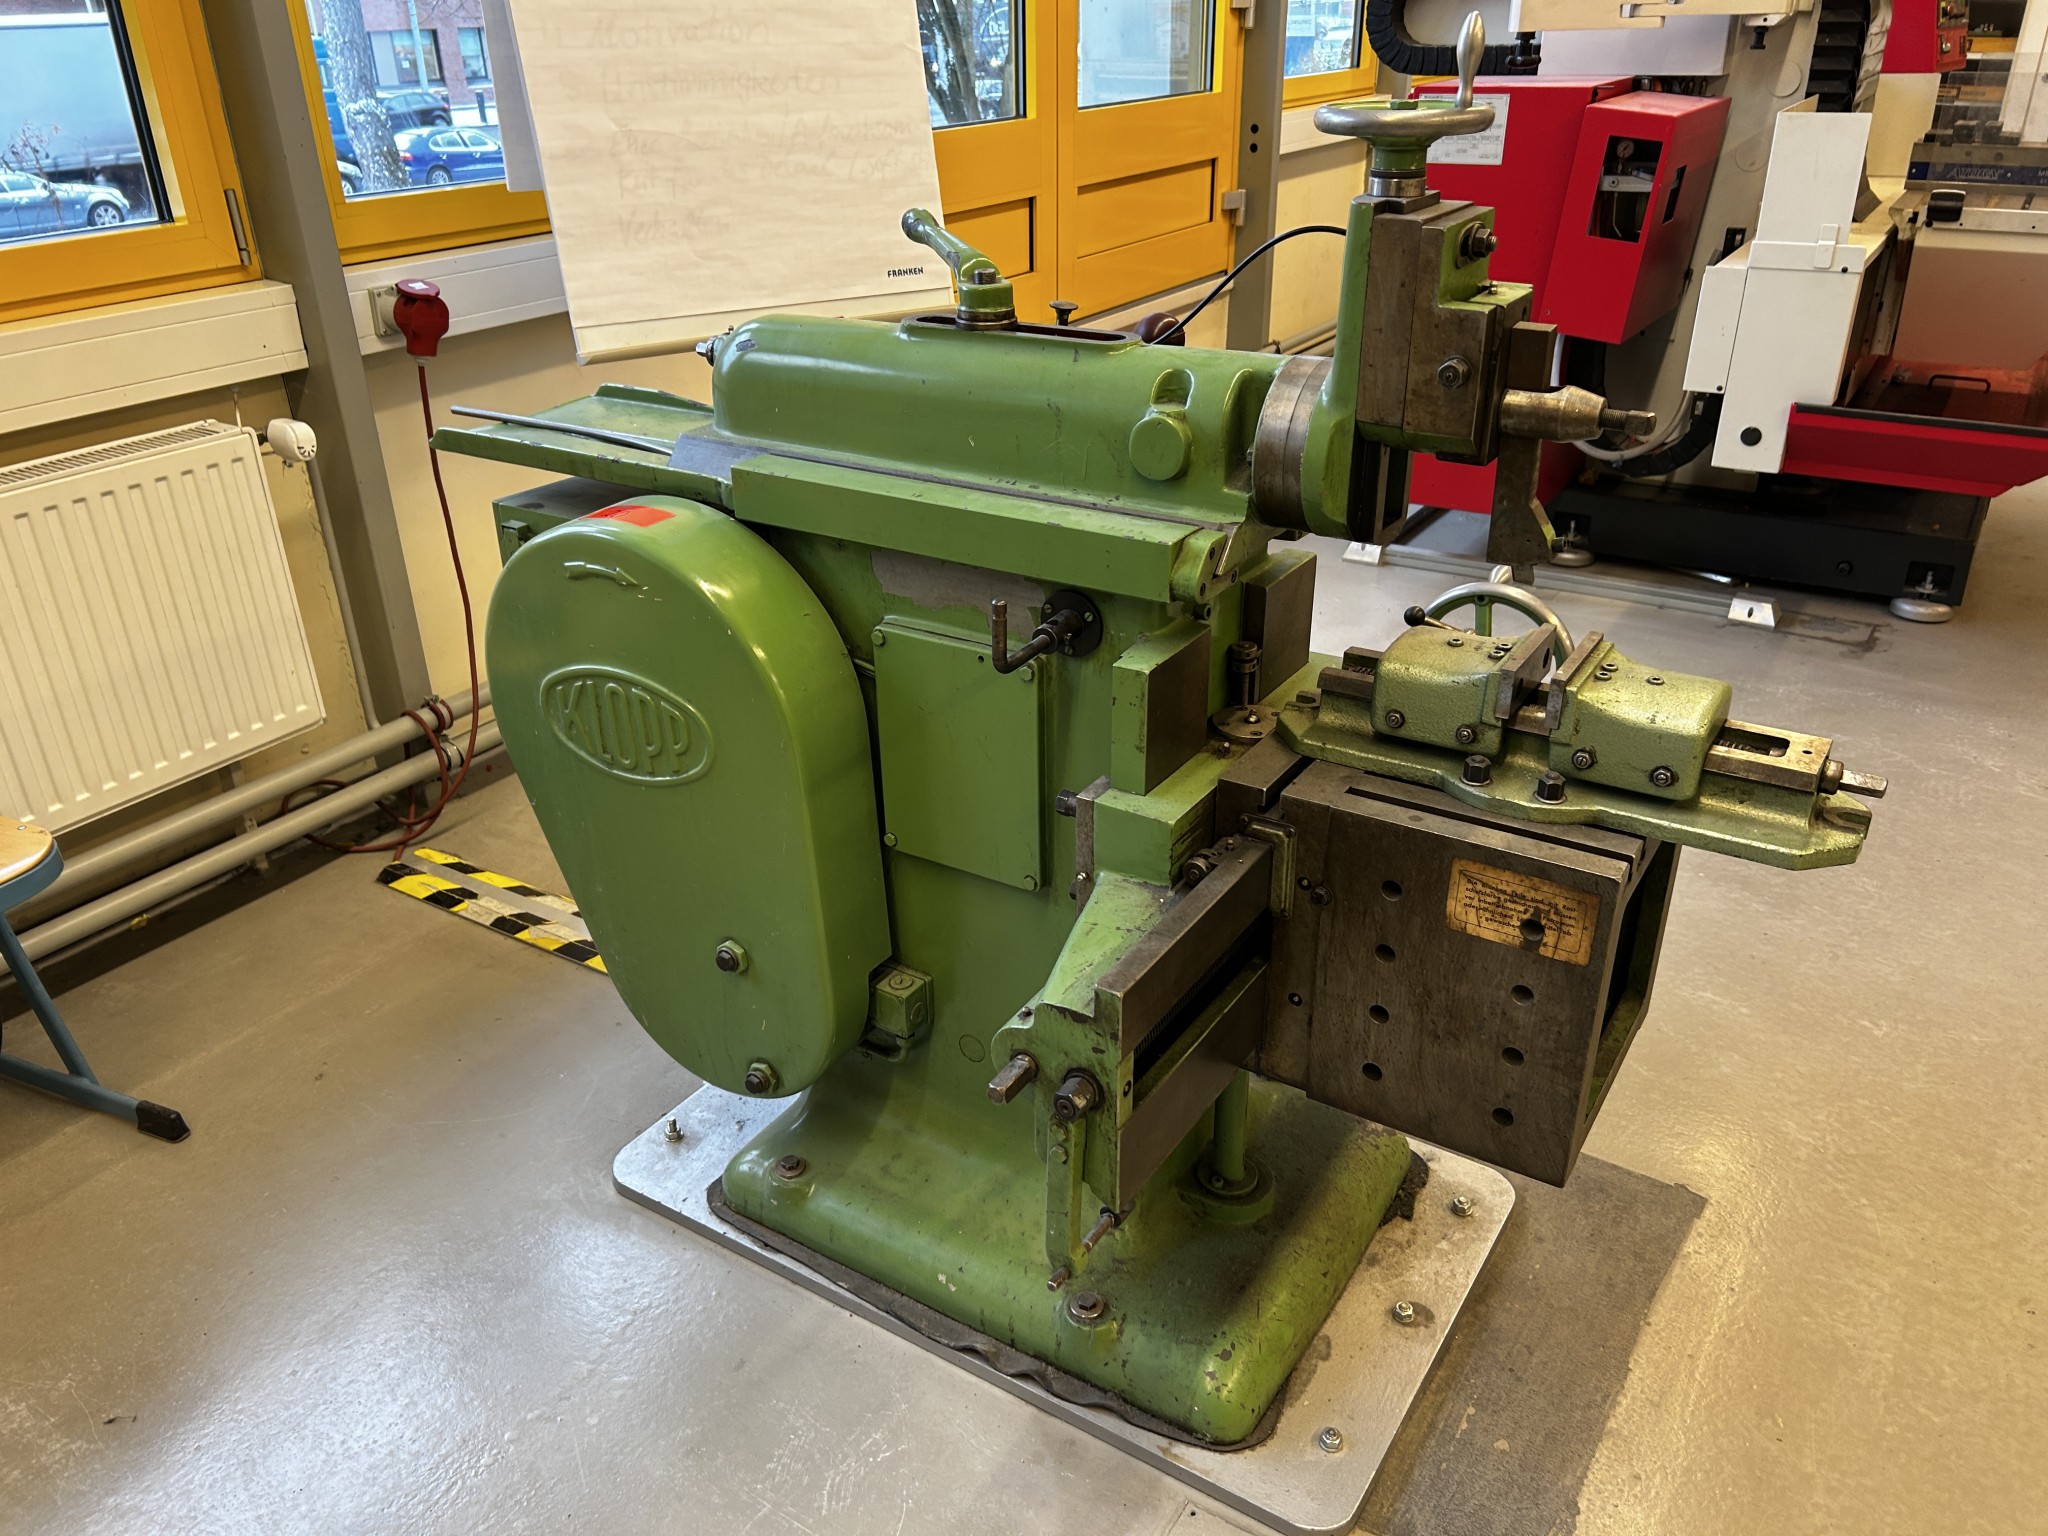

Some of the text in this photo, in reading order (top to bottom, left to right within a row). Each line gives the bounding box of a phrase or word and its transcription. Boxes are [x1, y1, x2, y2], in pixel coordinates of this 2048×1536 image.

[888, 267, 924, 278] FRANKEN
[555, 680, 691, 774] KLOPP
[1466, 878, 1477, 886] Die
